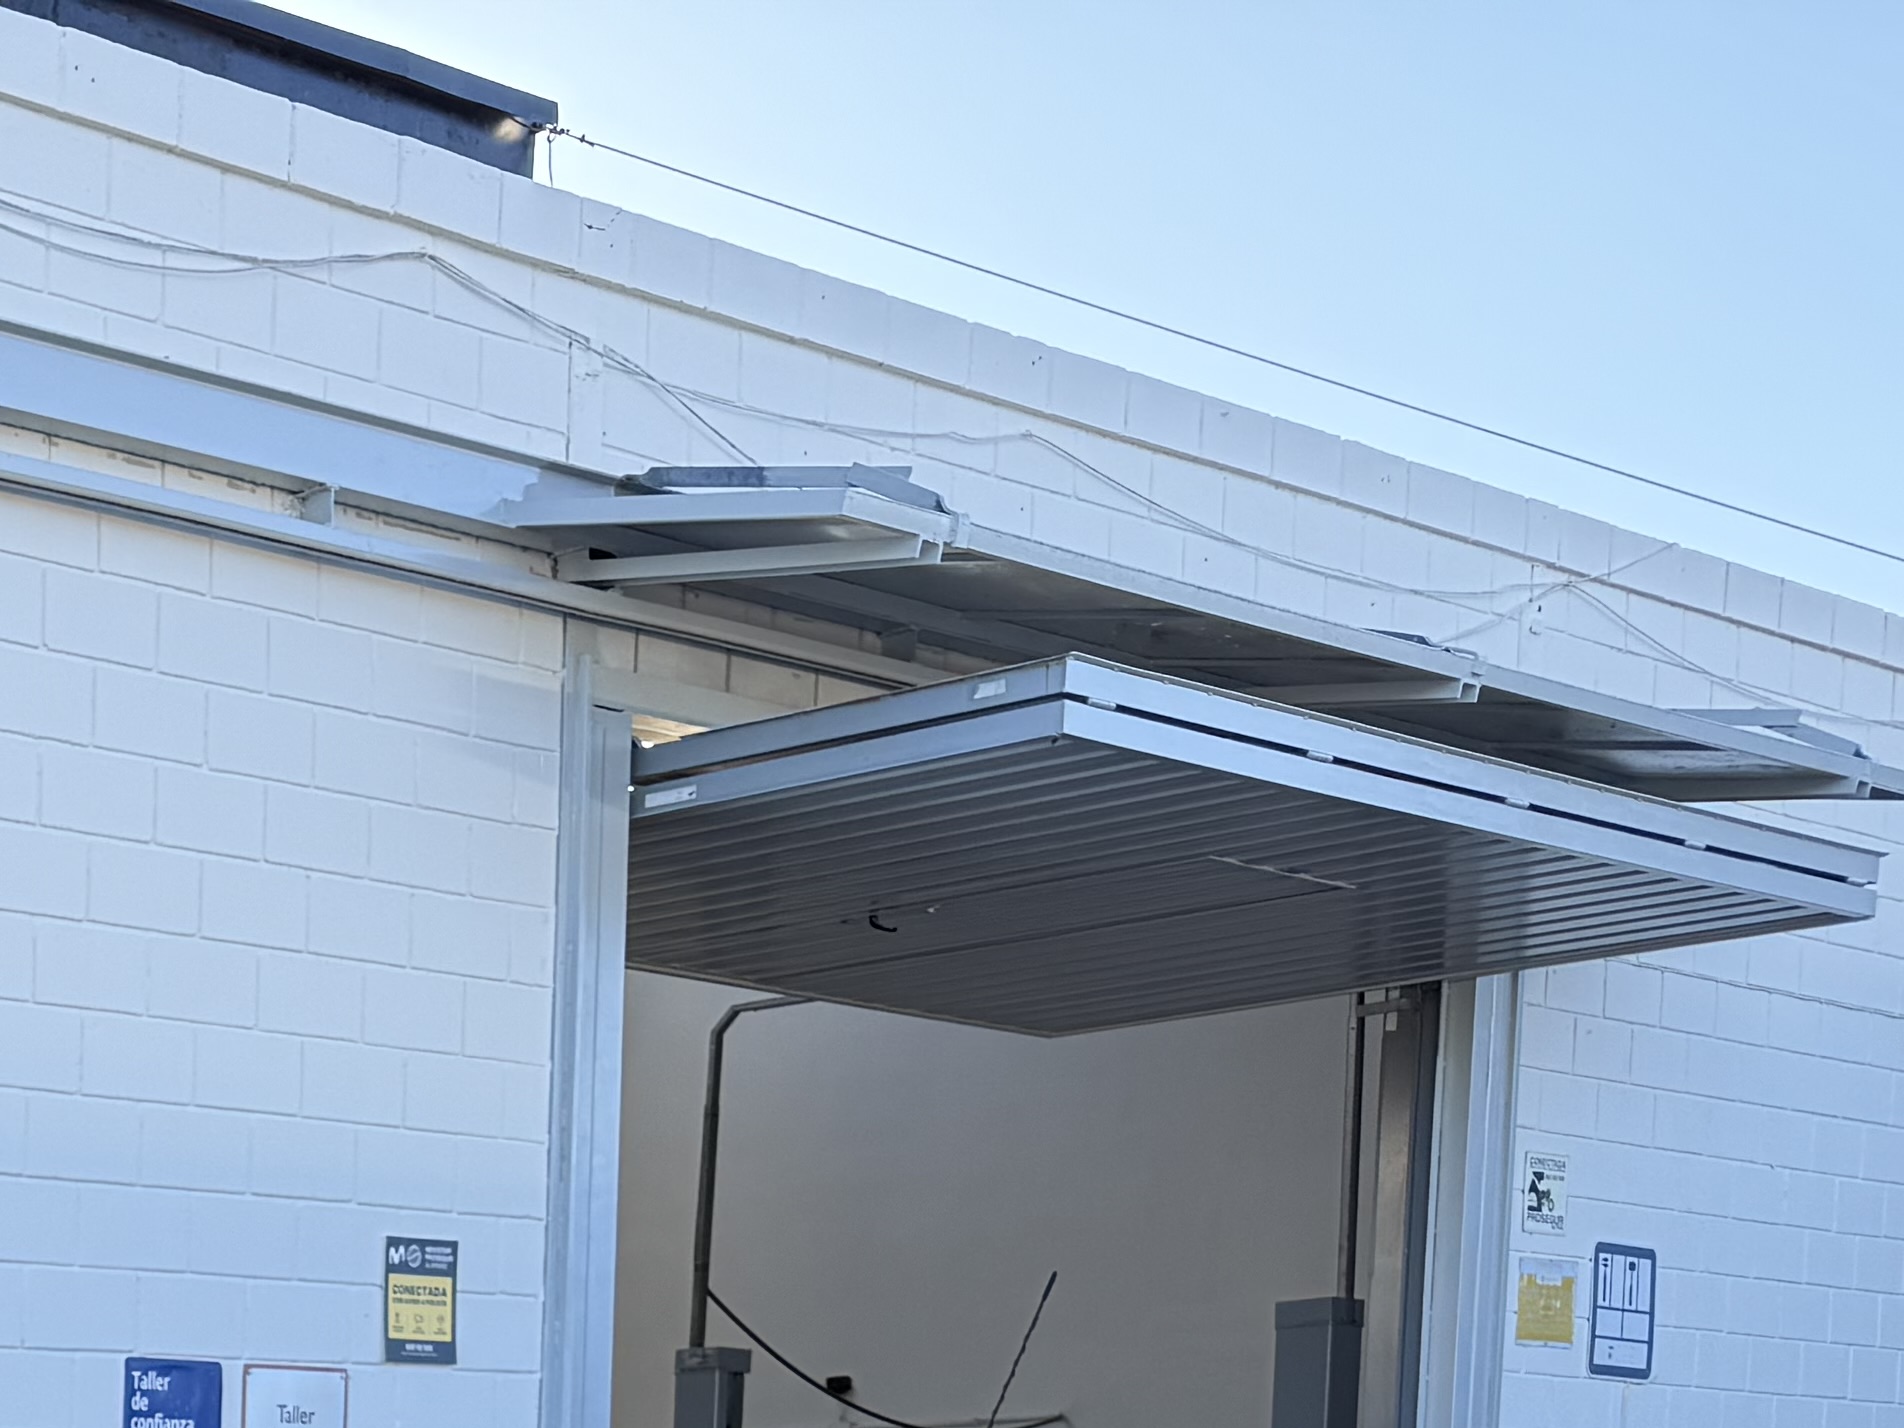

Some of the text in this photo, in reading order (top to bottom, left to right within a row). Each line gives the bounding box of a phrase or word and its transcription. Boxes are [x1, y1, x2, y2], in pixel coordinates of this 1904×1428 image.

[131, 1371, 171, 1391] Taller
[131, 1392, 149, 1411] de
[276, 1404, 315, 1425] Taller
